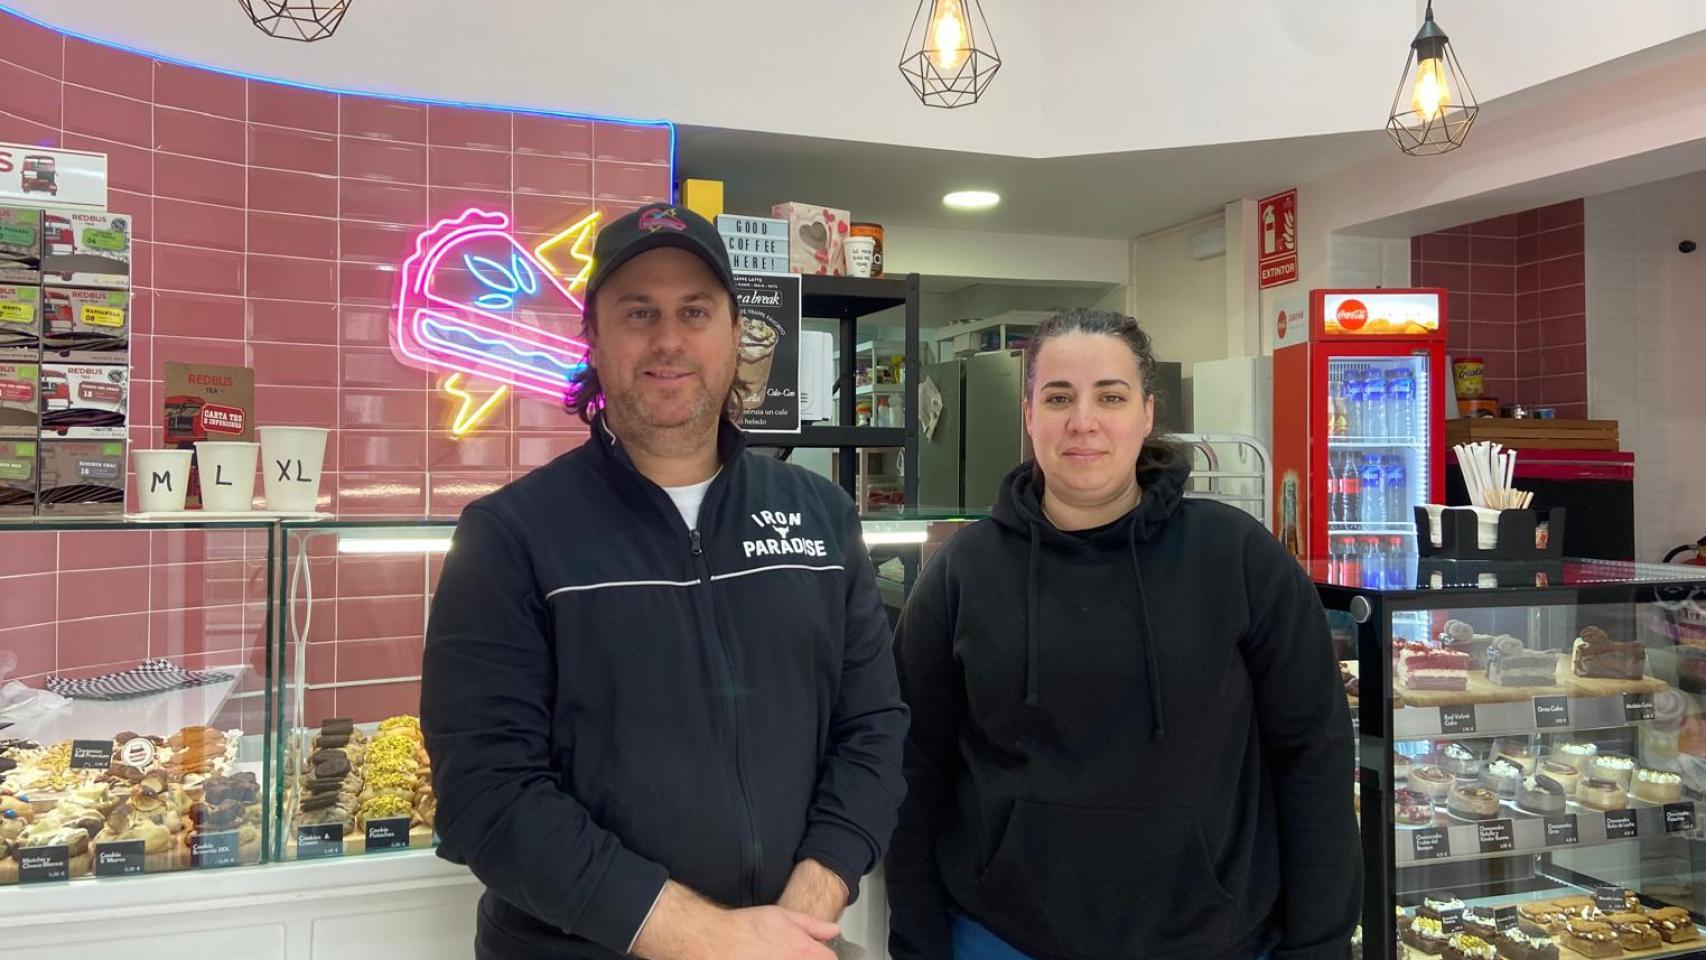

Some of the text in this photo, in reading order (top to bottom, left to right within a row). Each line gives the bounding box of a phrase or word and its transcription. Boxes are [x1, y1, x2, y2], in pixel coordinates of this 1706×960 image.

[736, 220, 768, 235] GOOD
[729, 237, 776, 253] COFFEE
[733, 256, 775, 270] HERE!
[1262, 262, 1295, 280] EXTINTOR
[751, 290, 780, 305] break
[67, 367, 104, 375] REDBUS
[187, 374, 233, 386] REDBUS
[204, 409, 227, 420] CARTA
[215, 464, 233, 486] L
[276, 459, 312, 483] XL
[150, 470, 172, 493] M
[751, 510, 802, 528] IRON
[742, 537, 828, 558] PARADISE
